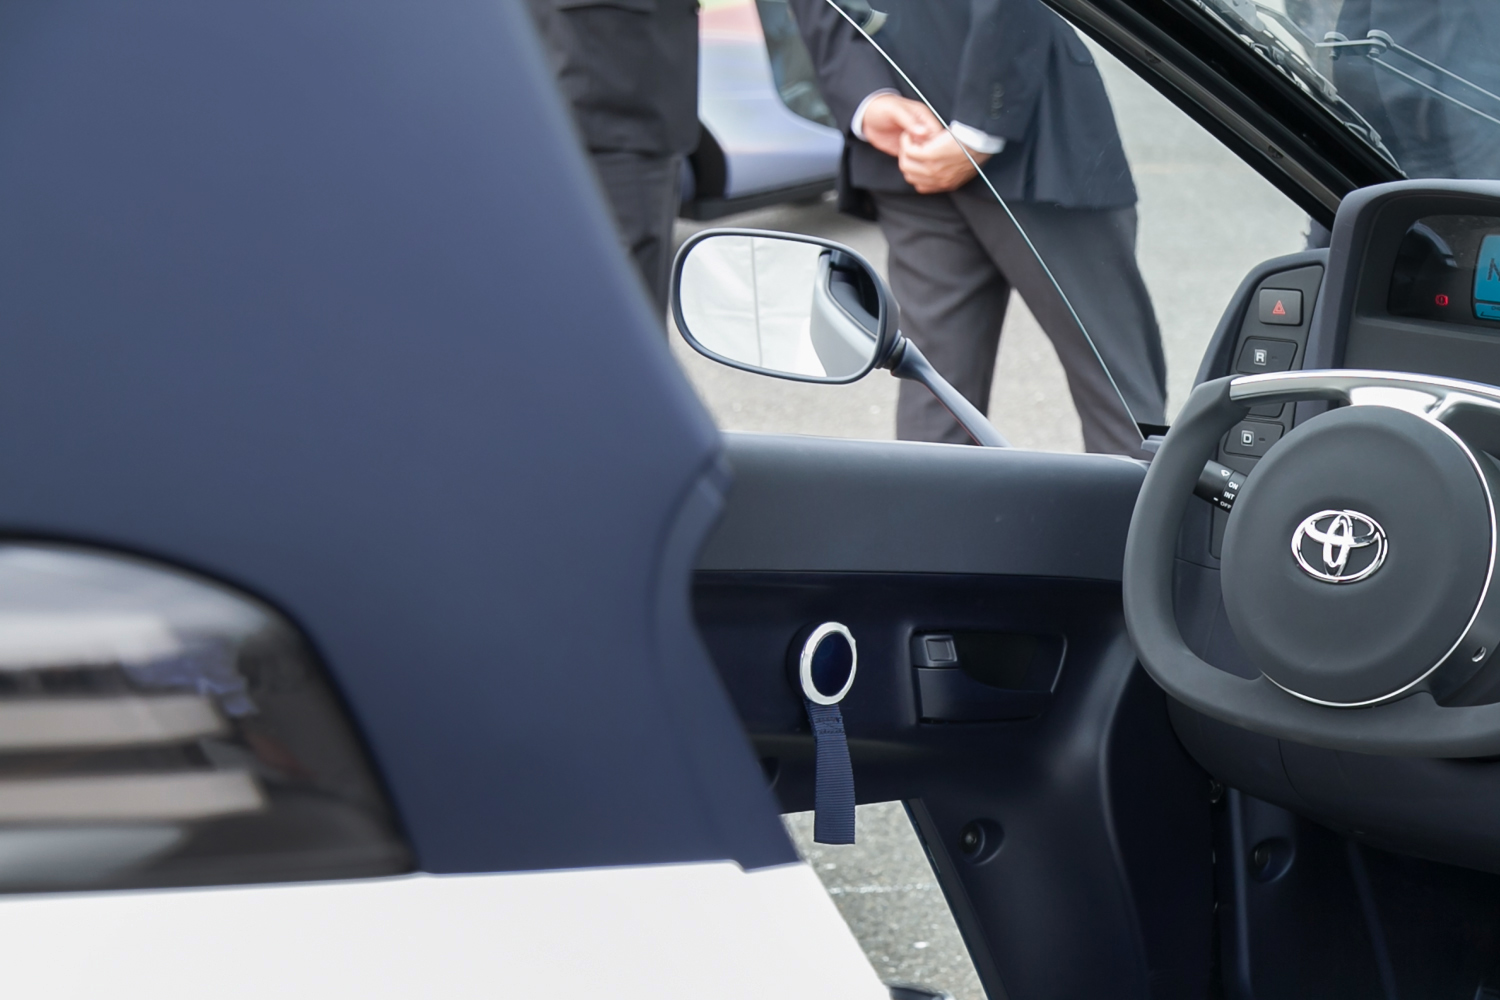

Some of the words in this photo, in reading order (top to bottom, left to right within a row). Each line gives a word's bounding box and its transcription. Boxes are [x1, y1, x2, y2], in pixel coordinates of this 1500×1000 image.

[1255, 352, 1265, 362] R
[1243, 433, 1252, 444] D
[1228, 481, 1239, 490] ON
[1223, 491, 1235, 500] INT
[1220, 501, 1231, 509] OFF
